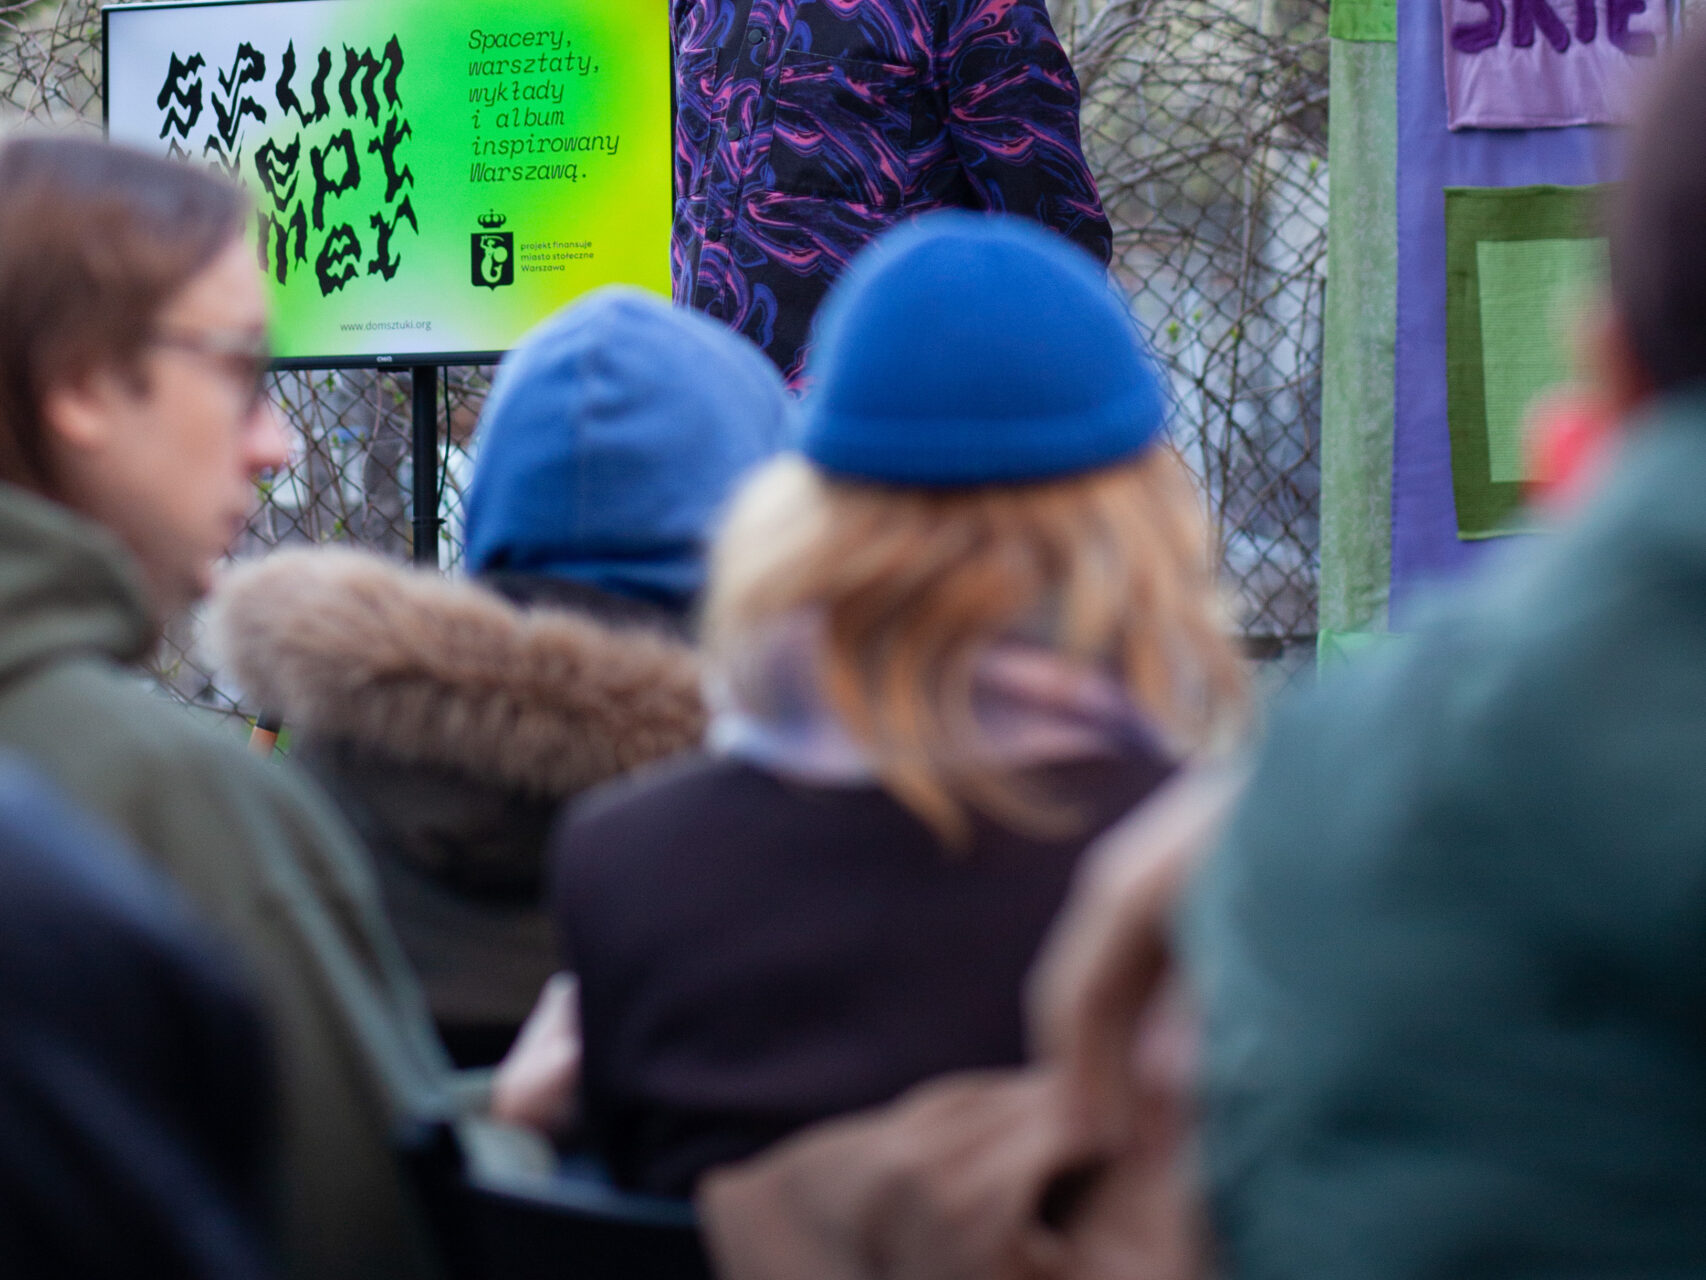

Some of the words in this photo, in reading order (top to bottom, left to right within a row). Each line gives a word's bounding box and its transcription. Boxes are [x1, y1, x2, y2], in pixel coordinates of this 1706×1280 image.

[468, 29, 571, 54] Spacery,
[468, 51, 600, 76] warsztaty,
[469, 80, 564, 107] wykłady
[471, 109, 480, 129] i
[496, 107, 564, 128] album
[472, 133, 619, 159] inspirowany
[470, 162, 586, 183] Warszawą.
[521, 242, 551, 251] projekt
[552, 240, 592, 249] finansuje
[521, 253, 551, 261] miasto
[552, 251, 594, 260] stołeczne
[521, 264, 565, 272] Warszawa
[340, 320, 432, 331] www.domsztuki.org
